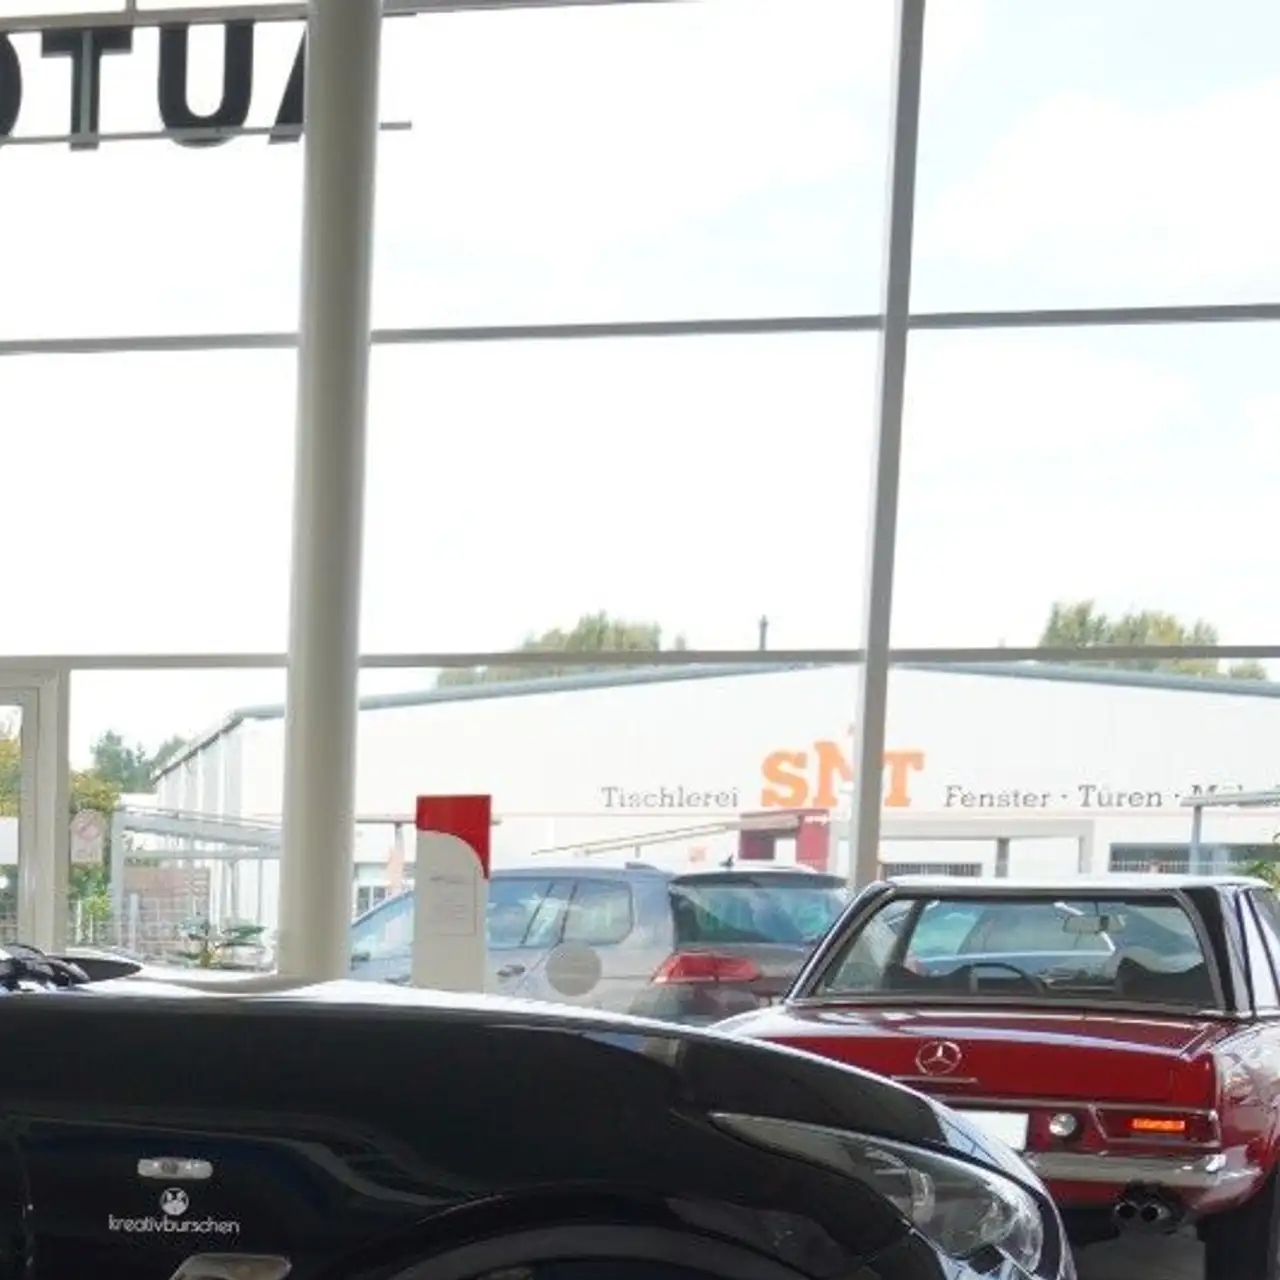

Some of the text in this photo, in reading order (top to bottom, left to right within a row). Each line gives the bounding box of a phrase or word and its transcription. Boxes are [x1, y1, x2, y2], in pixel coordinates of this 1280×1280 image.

[600, 785, 739, 808] Tischlerei
[943, 784, 1052, 808] Fenster
[108, 1213, 241, 1235] kreativburschen
